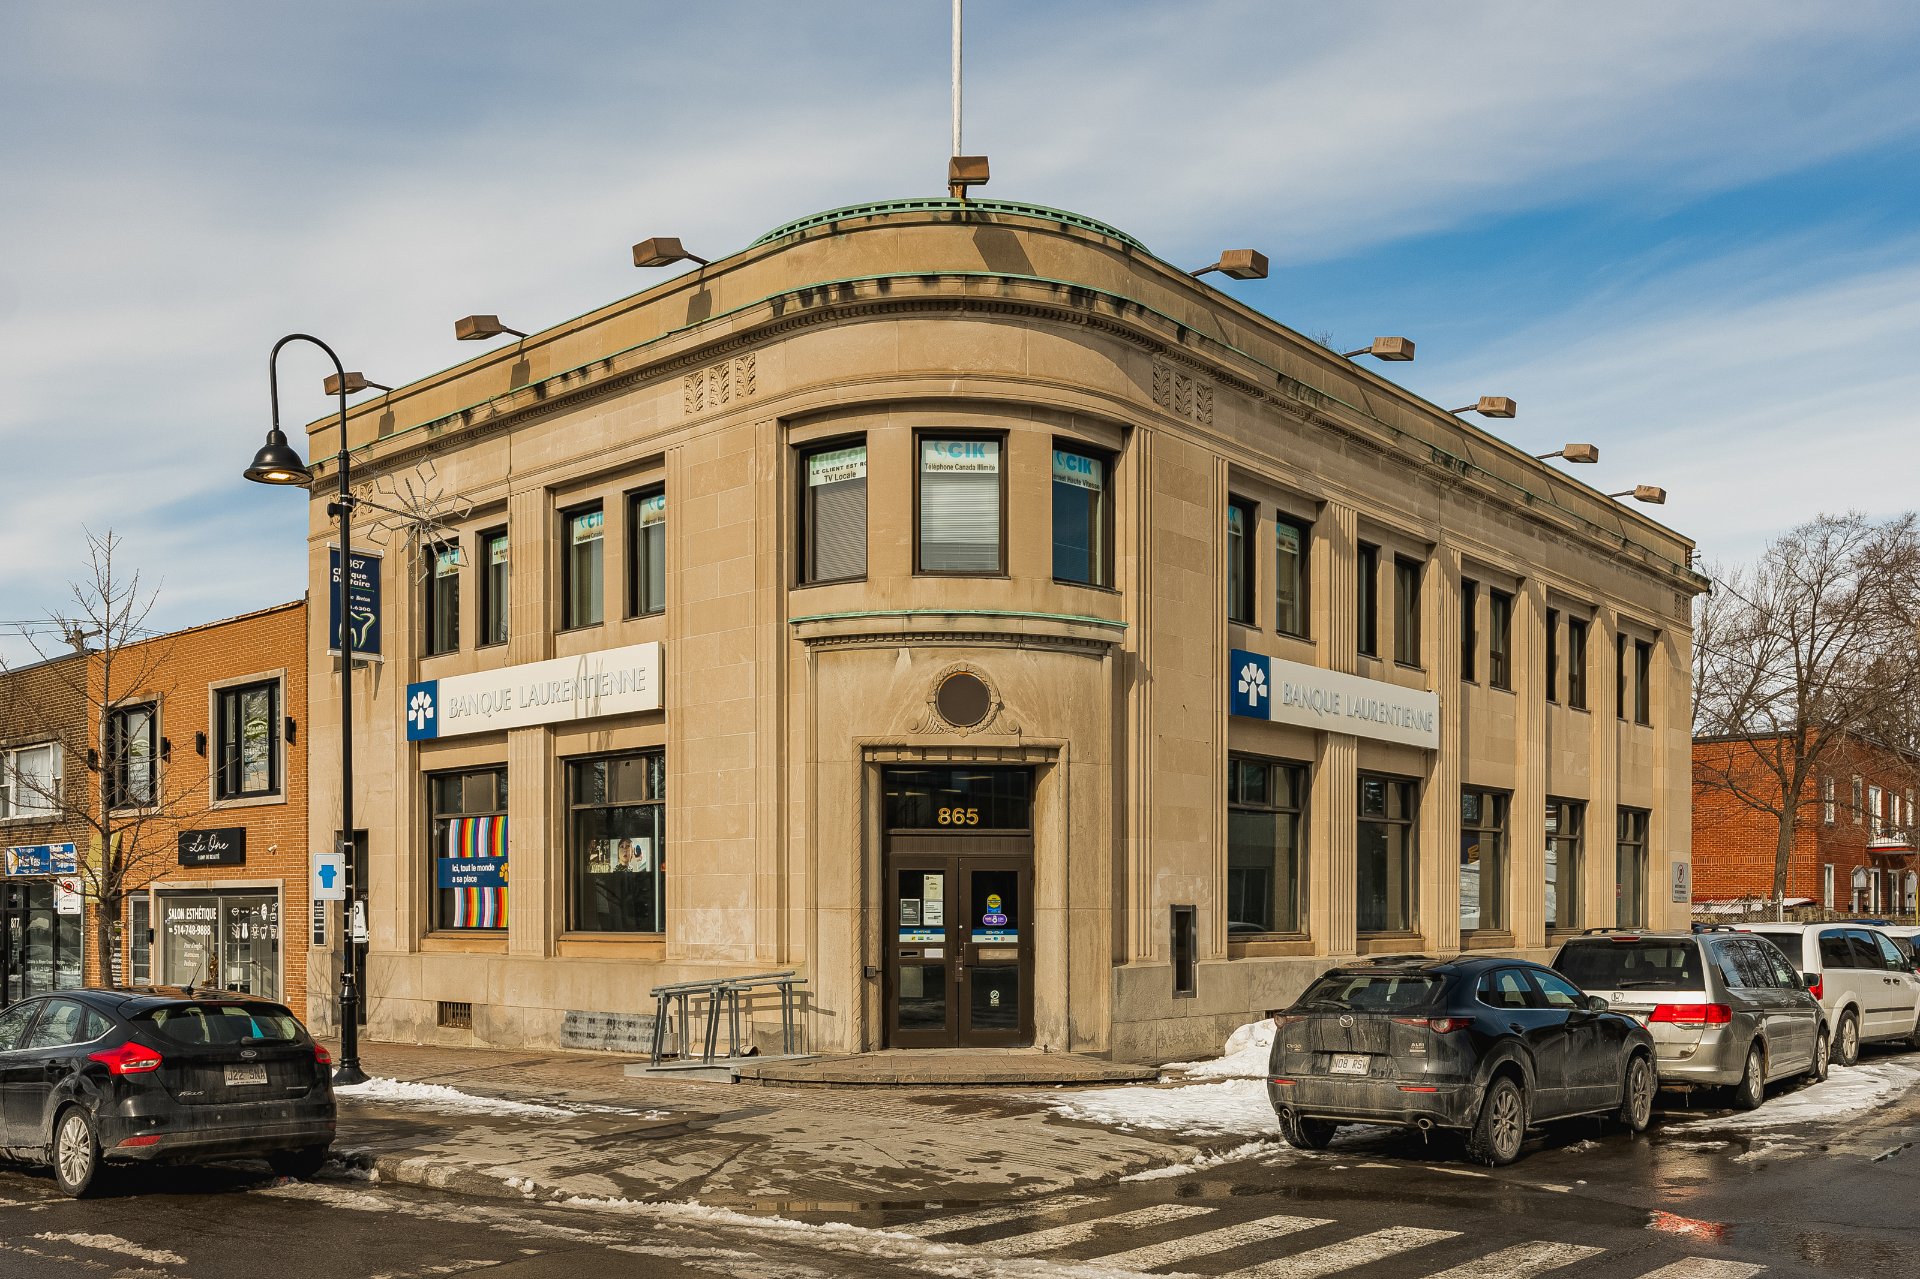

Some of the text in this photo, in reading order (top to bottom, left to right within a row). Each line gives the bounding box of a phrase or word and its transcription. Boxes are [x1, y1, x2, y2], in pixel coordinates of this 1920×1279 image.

[947, 442, 986, 459] CIK
[821, 465, 844, 474] CLIENT
[845, 462, 858, 470] EST
[954, 463, 976, 471] Canada
[1066, 455, 1092, 475] CIK
[823, 470, 857, 482] TV Locale
[448, 666, 646, 719] BANQUE LAURENTIENNE
[1282, 681, 1433, 732] BANQUE LAURENTIENNE
[938, 807, 979, 825] 865
[471, 864, 476, 872] le
[476, 863, 495, 872] monde
[464, 874, 478, 884] place
[168, 905, 217, 921] SALON ESTHÉTIQUE
[10, 918, 20, 928] 877
[249, 1068, 266, 1080] SNA
